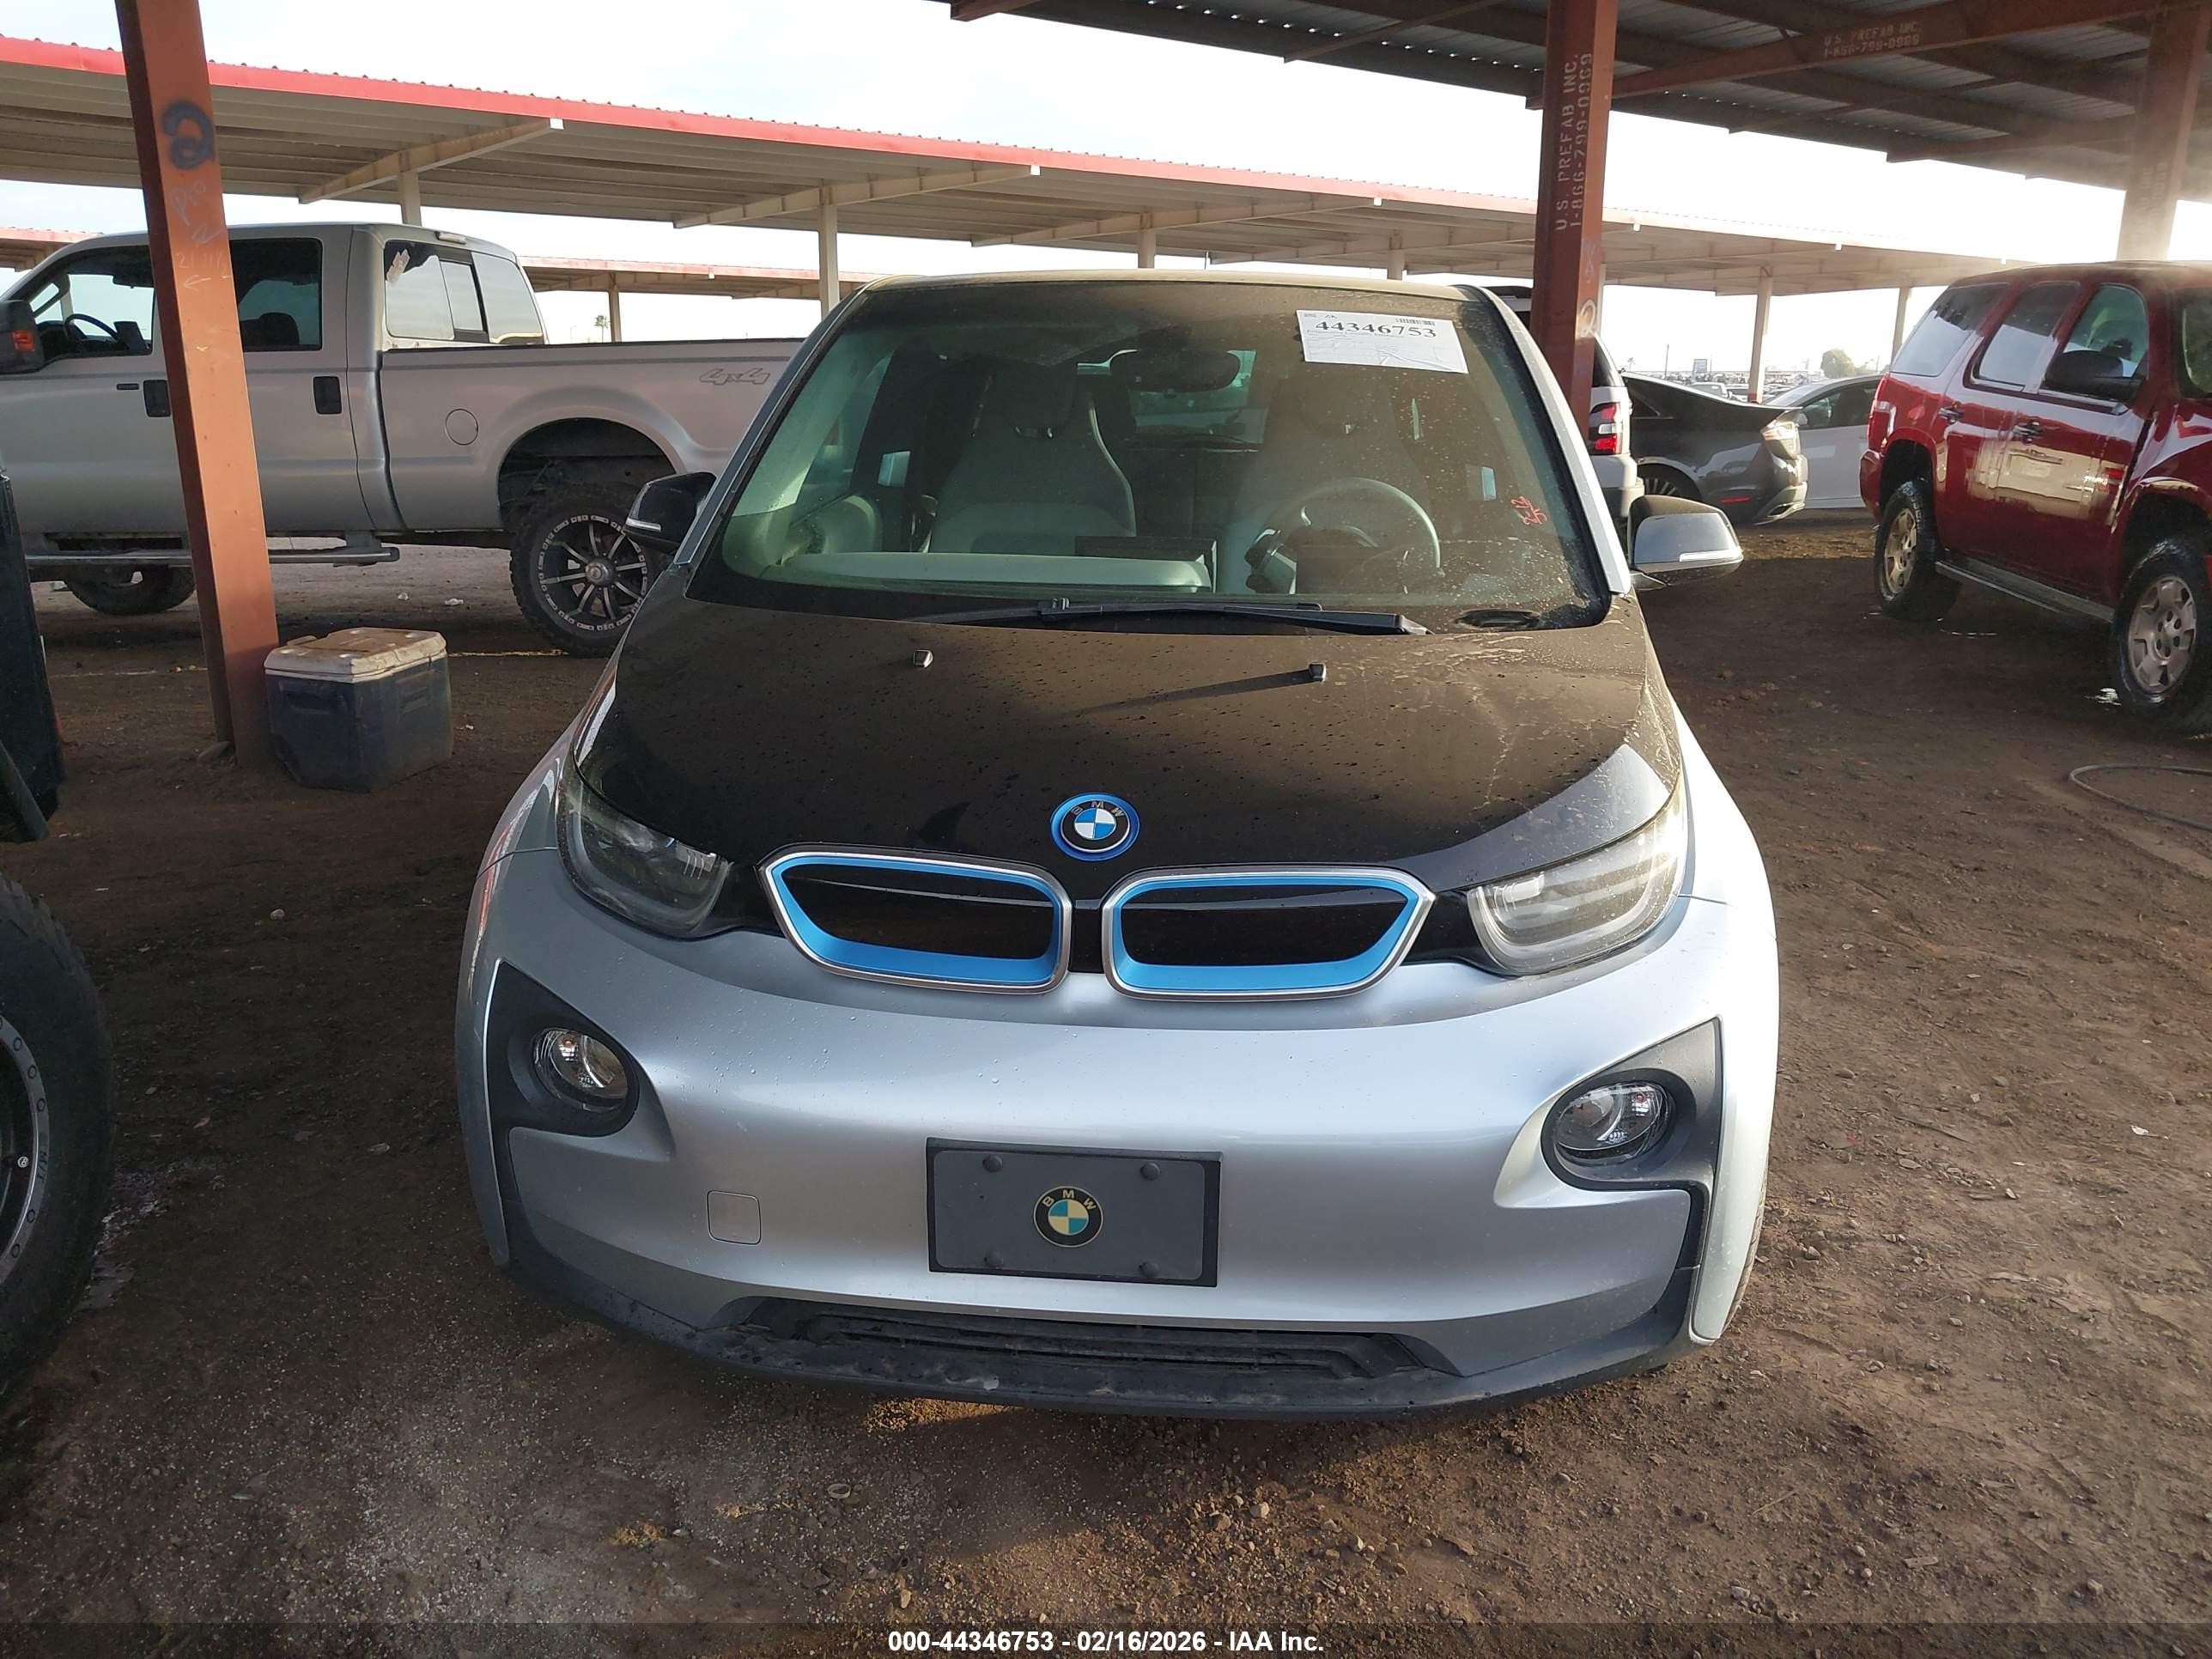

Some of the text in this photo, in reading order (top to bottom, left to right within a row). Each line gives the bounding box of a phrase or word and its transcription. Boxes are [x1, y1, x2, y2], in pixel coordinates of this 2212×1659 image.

[1558, 104, 1574, 183] PREFAB
[1316, 320, 1437, 338] 44346753
[1070, 800, 1126, 818] BMW
[1042, 1189, 1097, 1211] BMW
